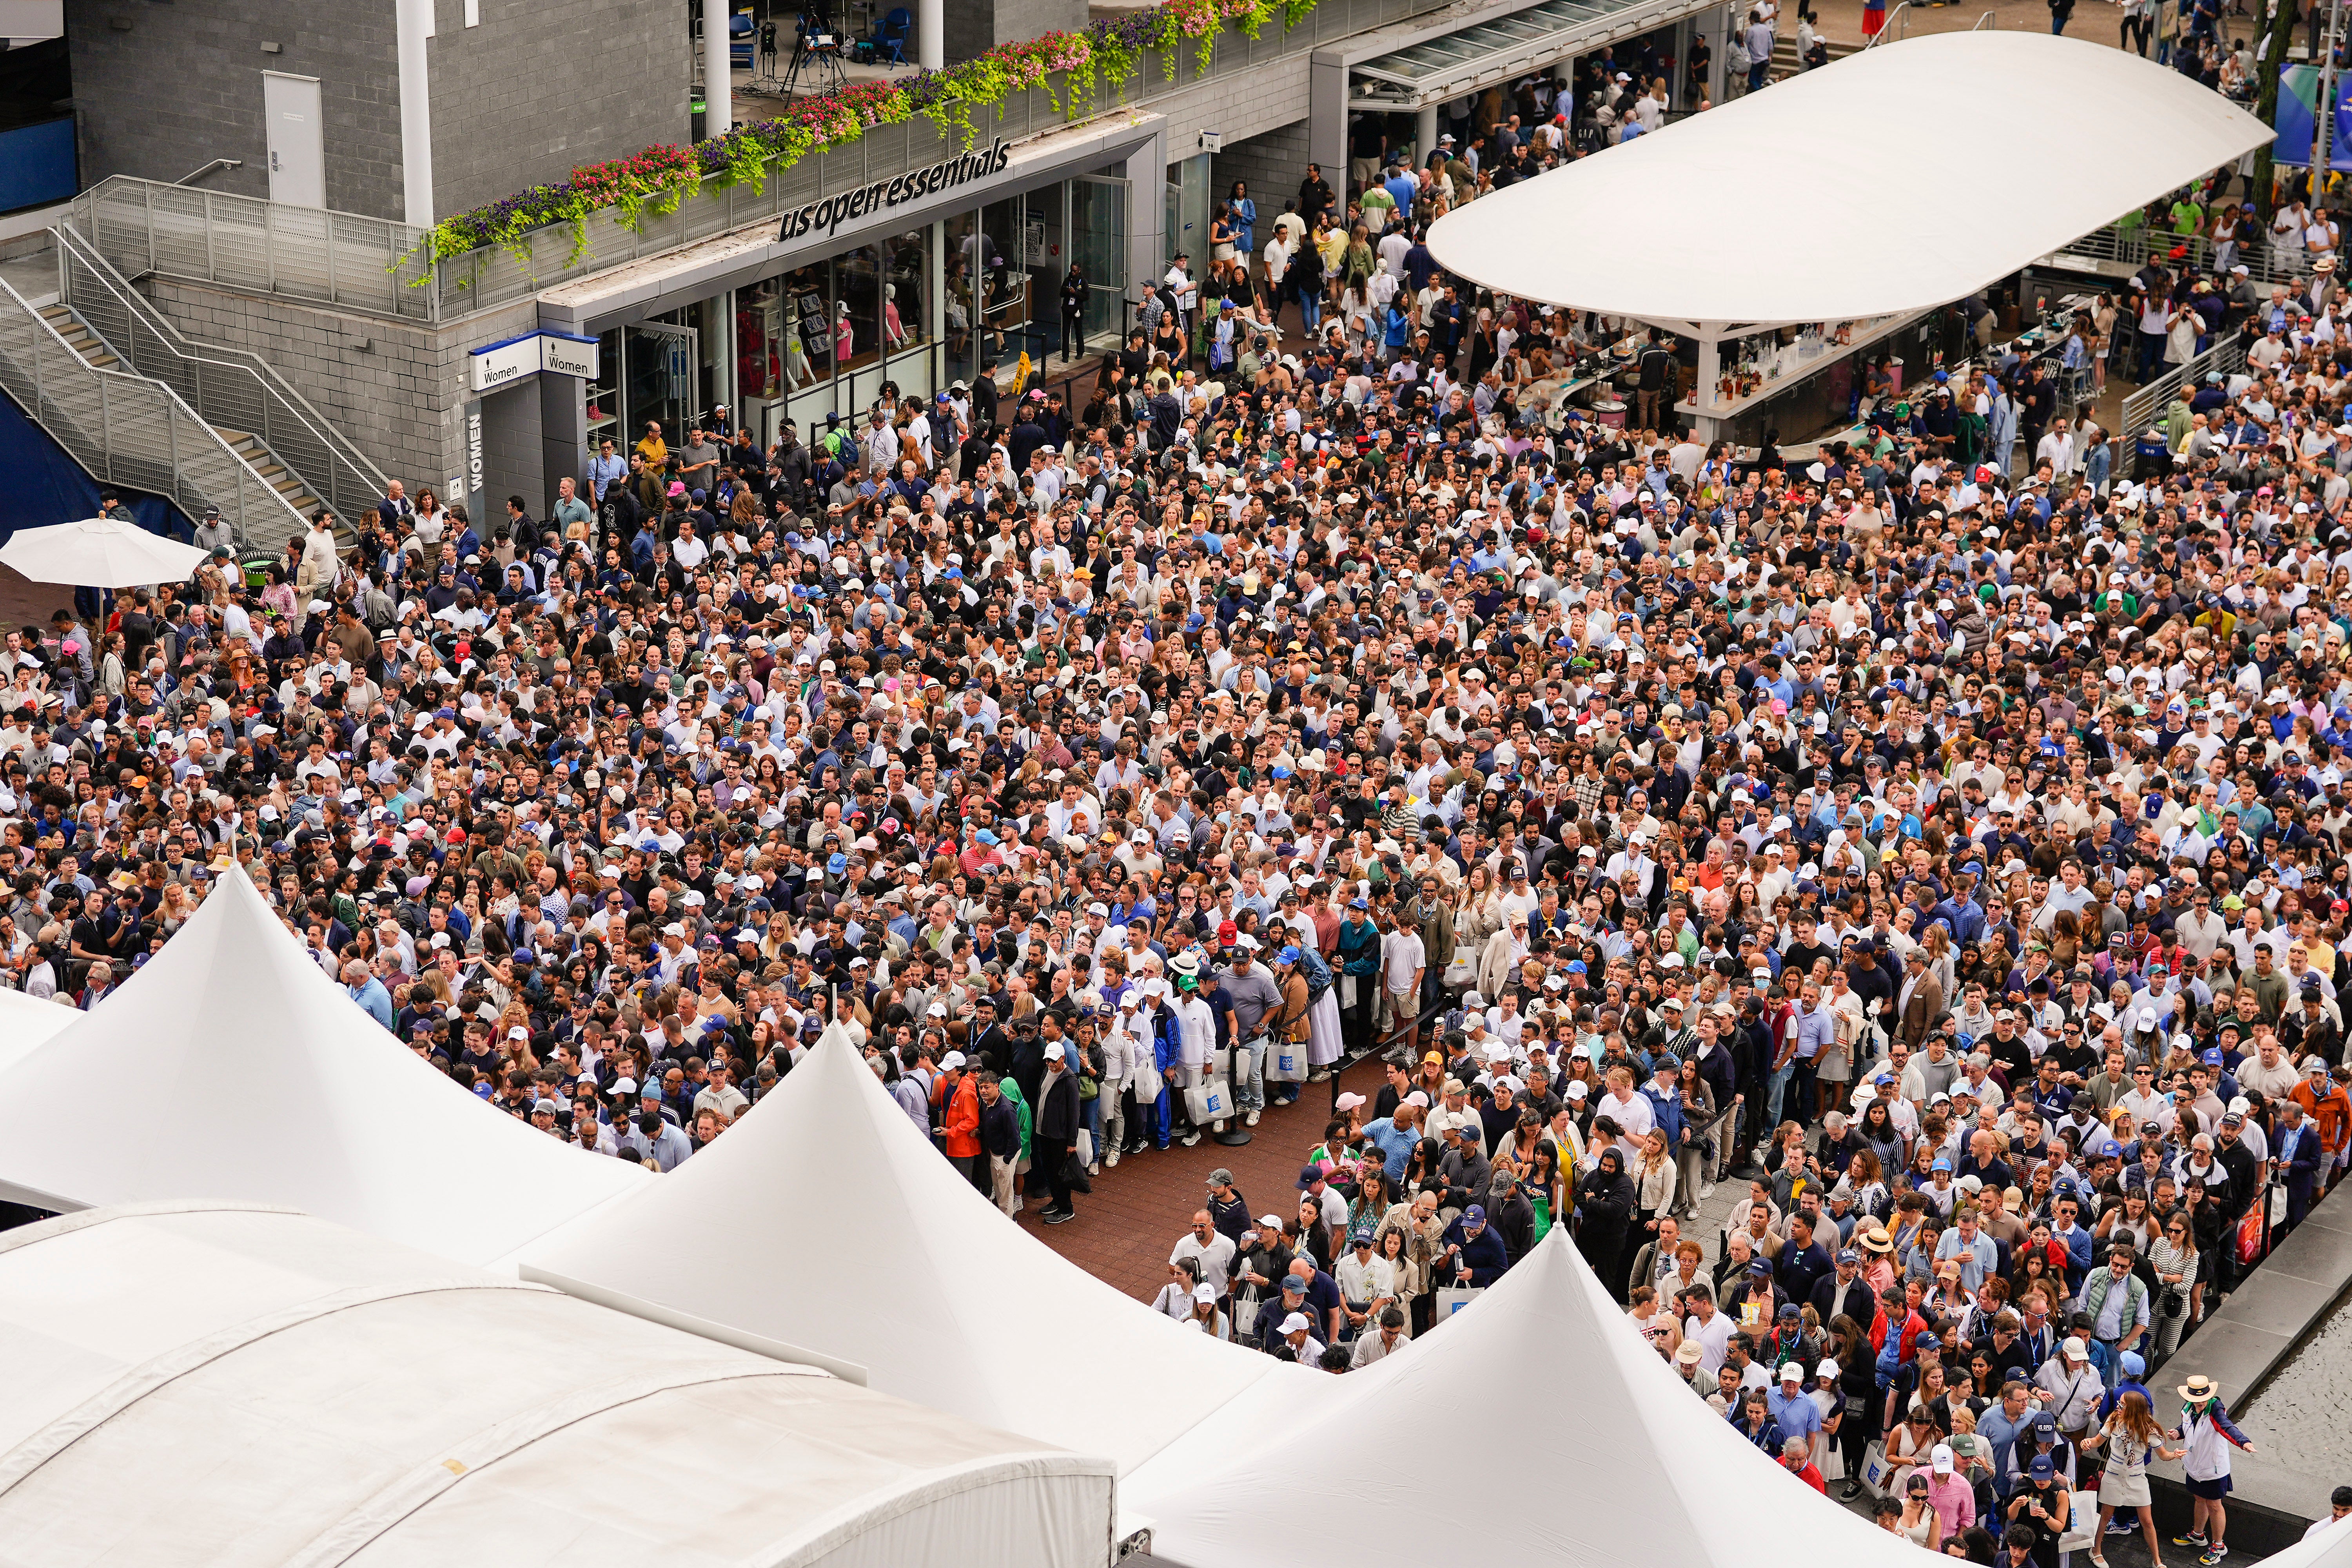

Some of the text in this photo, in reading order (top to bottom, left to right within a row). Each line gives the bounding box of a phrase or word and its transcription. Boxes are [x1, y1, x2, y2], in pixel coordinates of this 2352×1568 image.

[1578, 129, 1594, 138] GAP
[779, 136, 1011, 241] us open essentials
[549, 356, 588, 374] Women
[484, 366, 517, 384] Women
[468, 414, 483, 492] WOMEN
[538, 553, 548, 568] OPEN
[1532, 1187, 1547, 1198] OPEN
[1869, 1473, 1877, 1483] EX
[1870, 1466, 1880, 1477] AM
